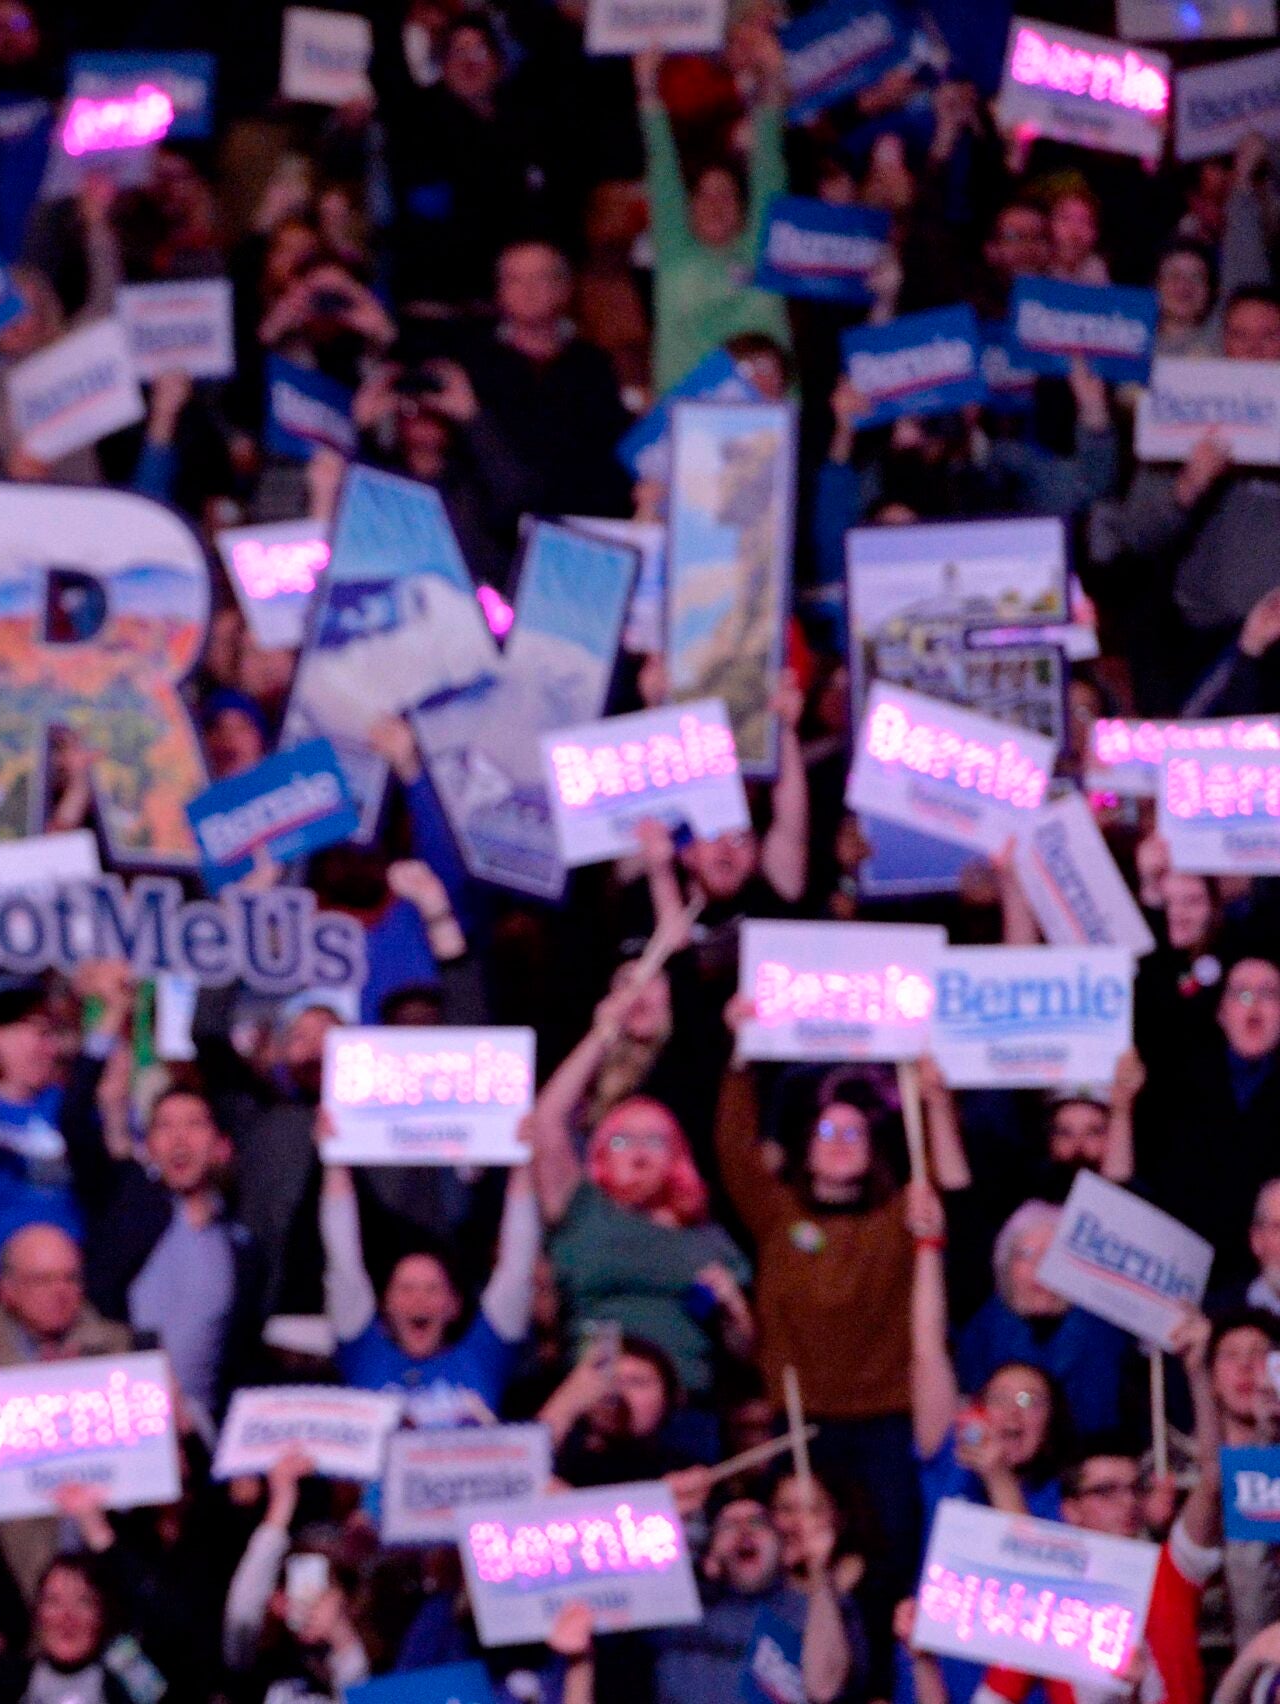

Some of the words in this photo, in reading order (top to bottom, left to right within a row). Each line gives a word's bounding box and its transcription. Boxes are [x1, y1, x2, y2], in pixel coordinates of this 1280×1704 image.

[936, 962, 1128, 1026] Bernie
[1066, 1208, 1198, 1300] Bernie
[468, 1503, 680, 1584] Bernie
